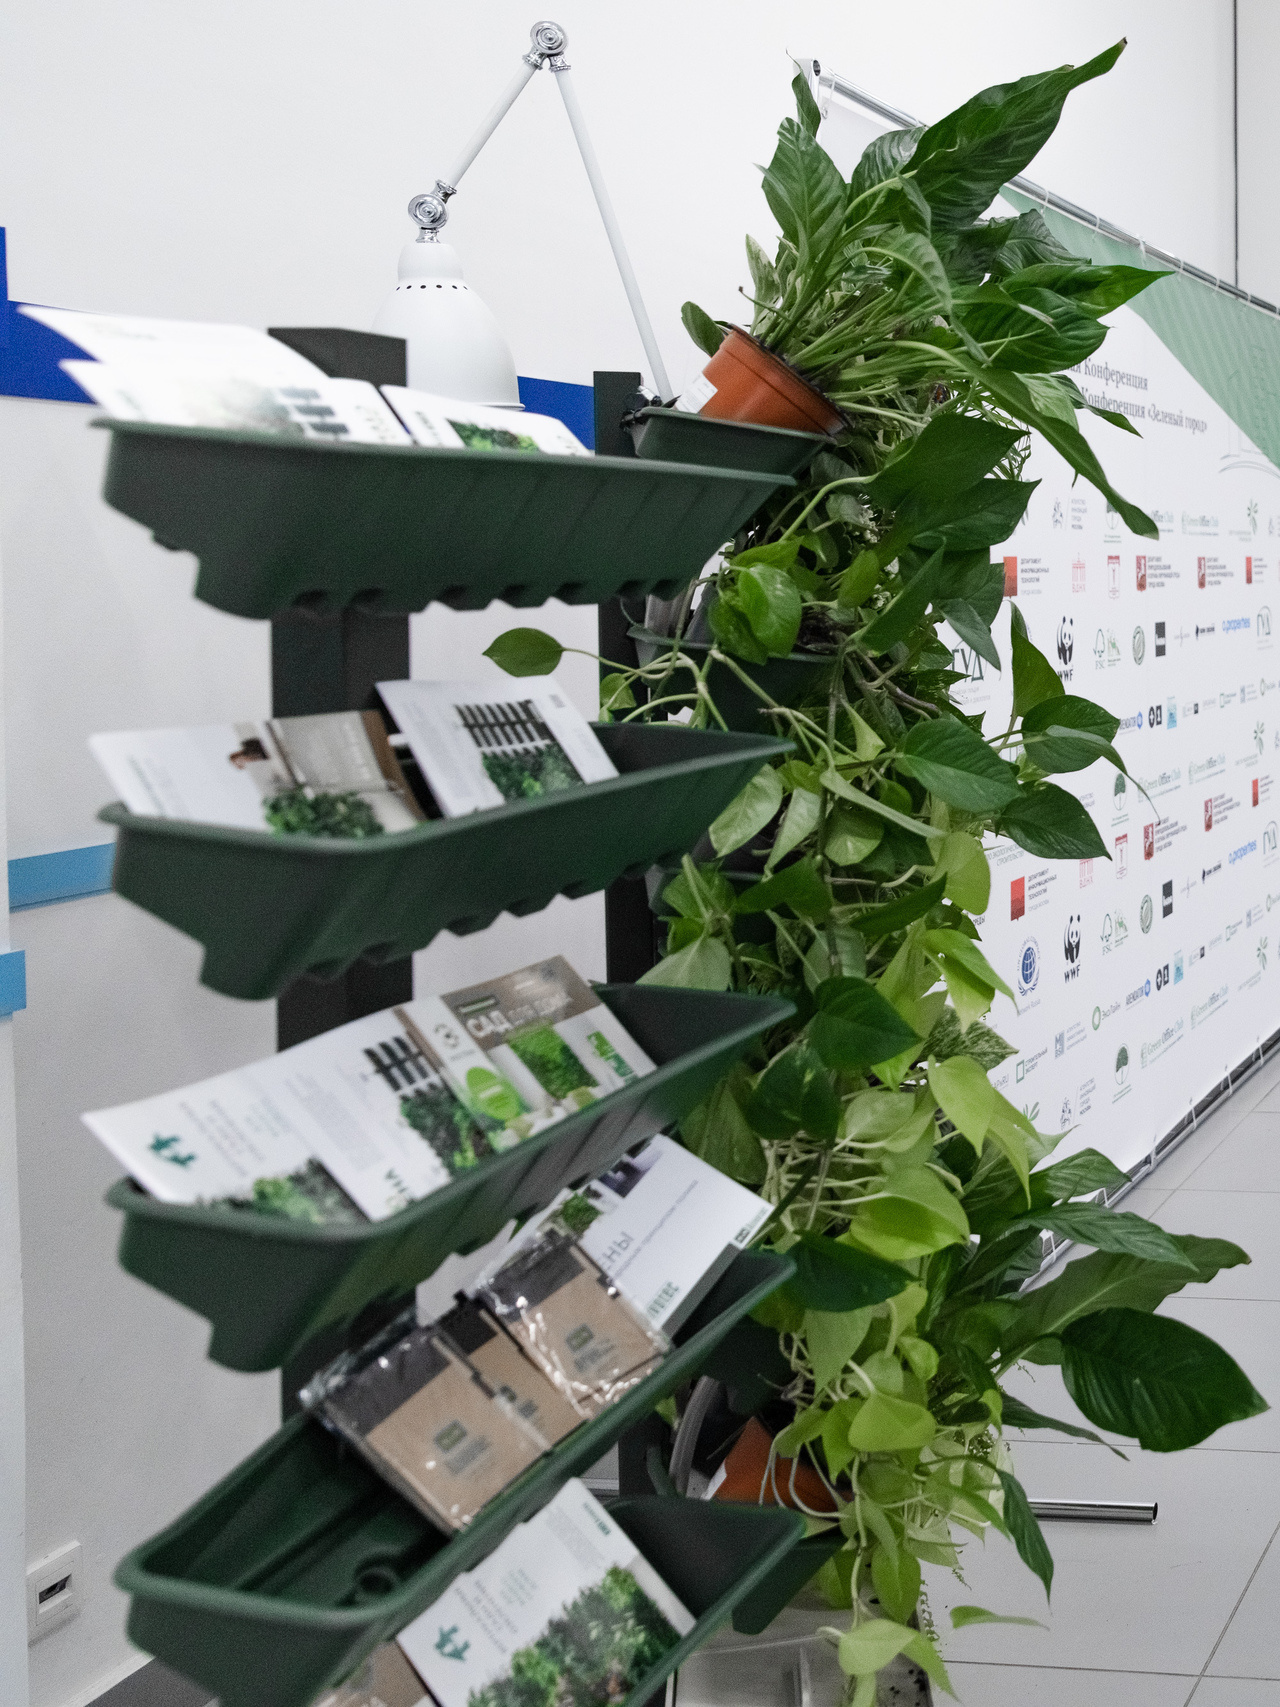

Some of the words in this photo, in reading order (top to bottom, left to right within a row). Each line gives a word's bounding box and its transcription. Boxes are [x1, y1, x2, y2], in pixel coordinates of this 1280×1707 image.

[1083, 357, 1148, 391] Конференция
[1081, 386, 1146, 419] Конференция
[1064, 964, 1081, 983] WWF
